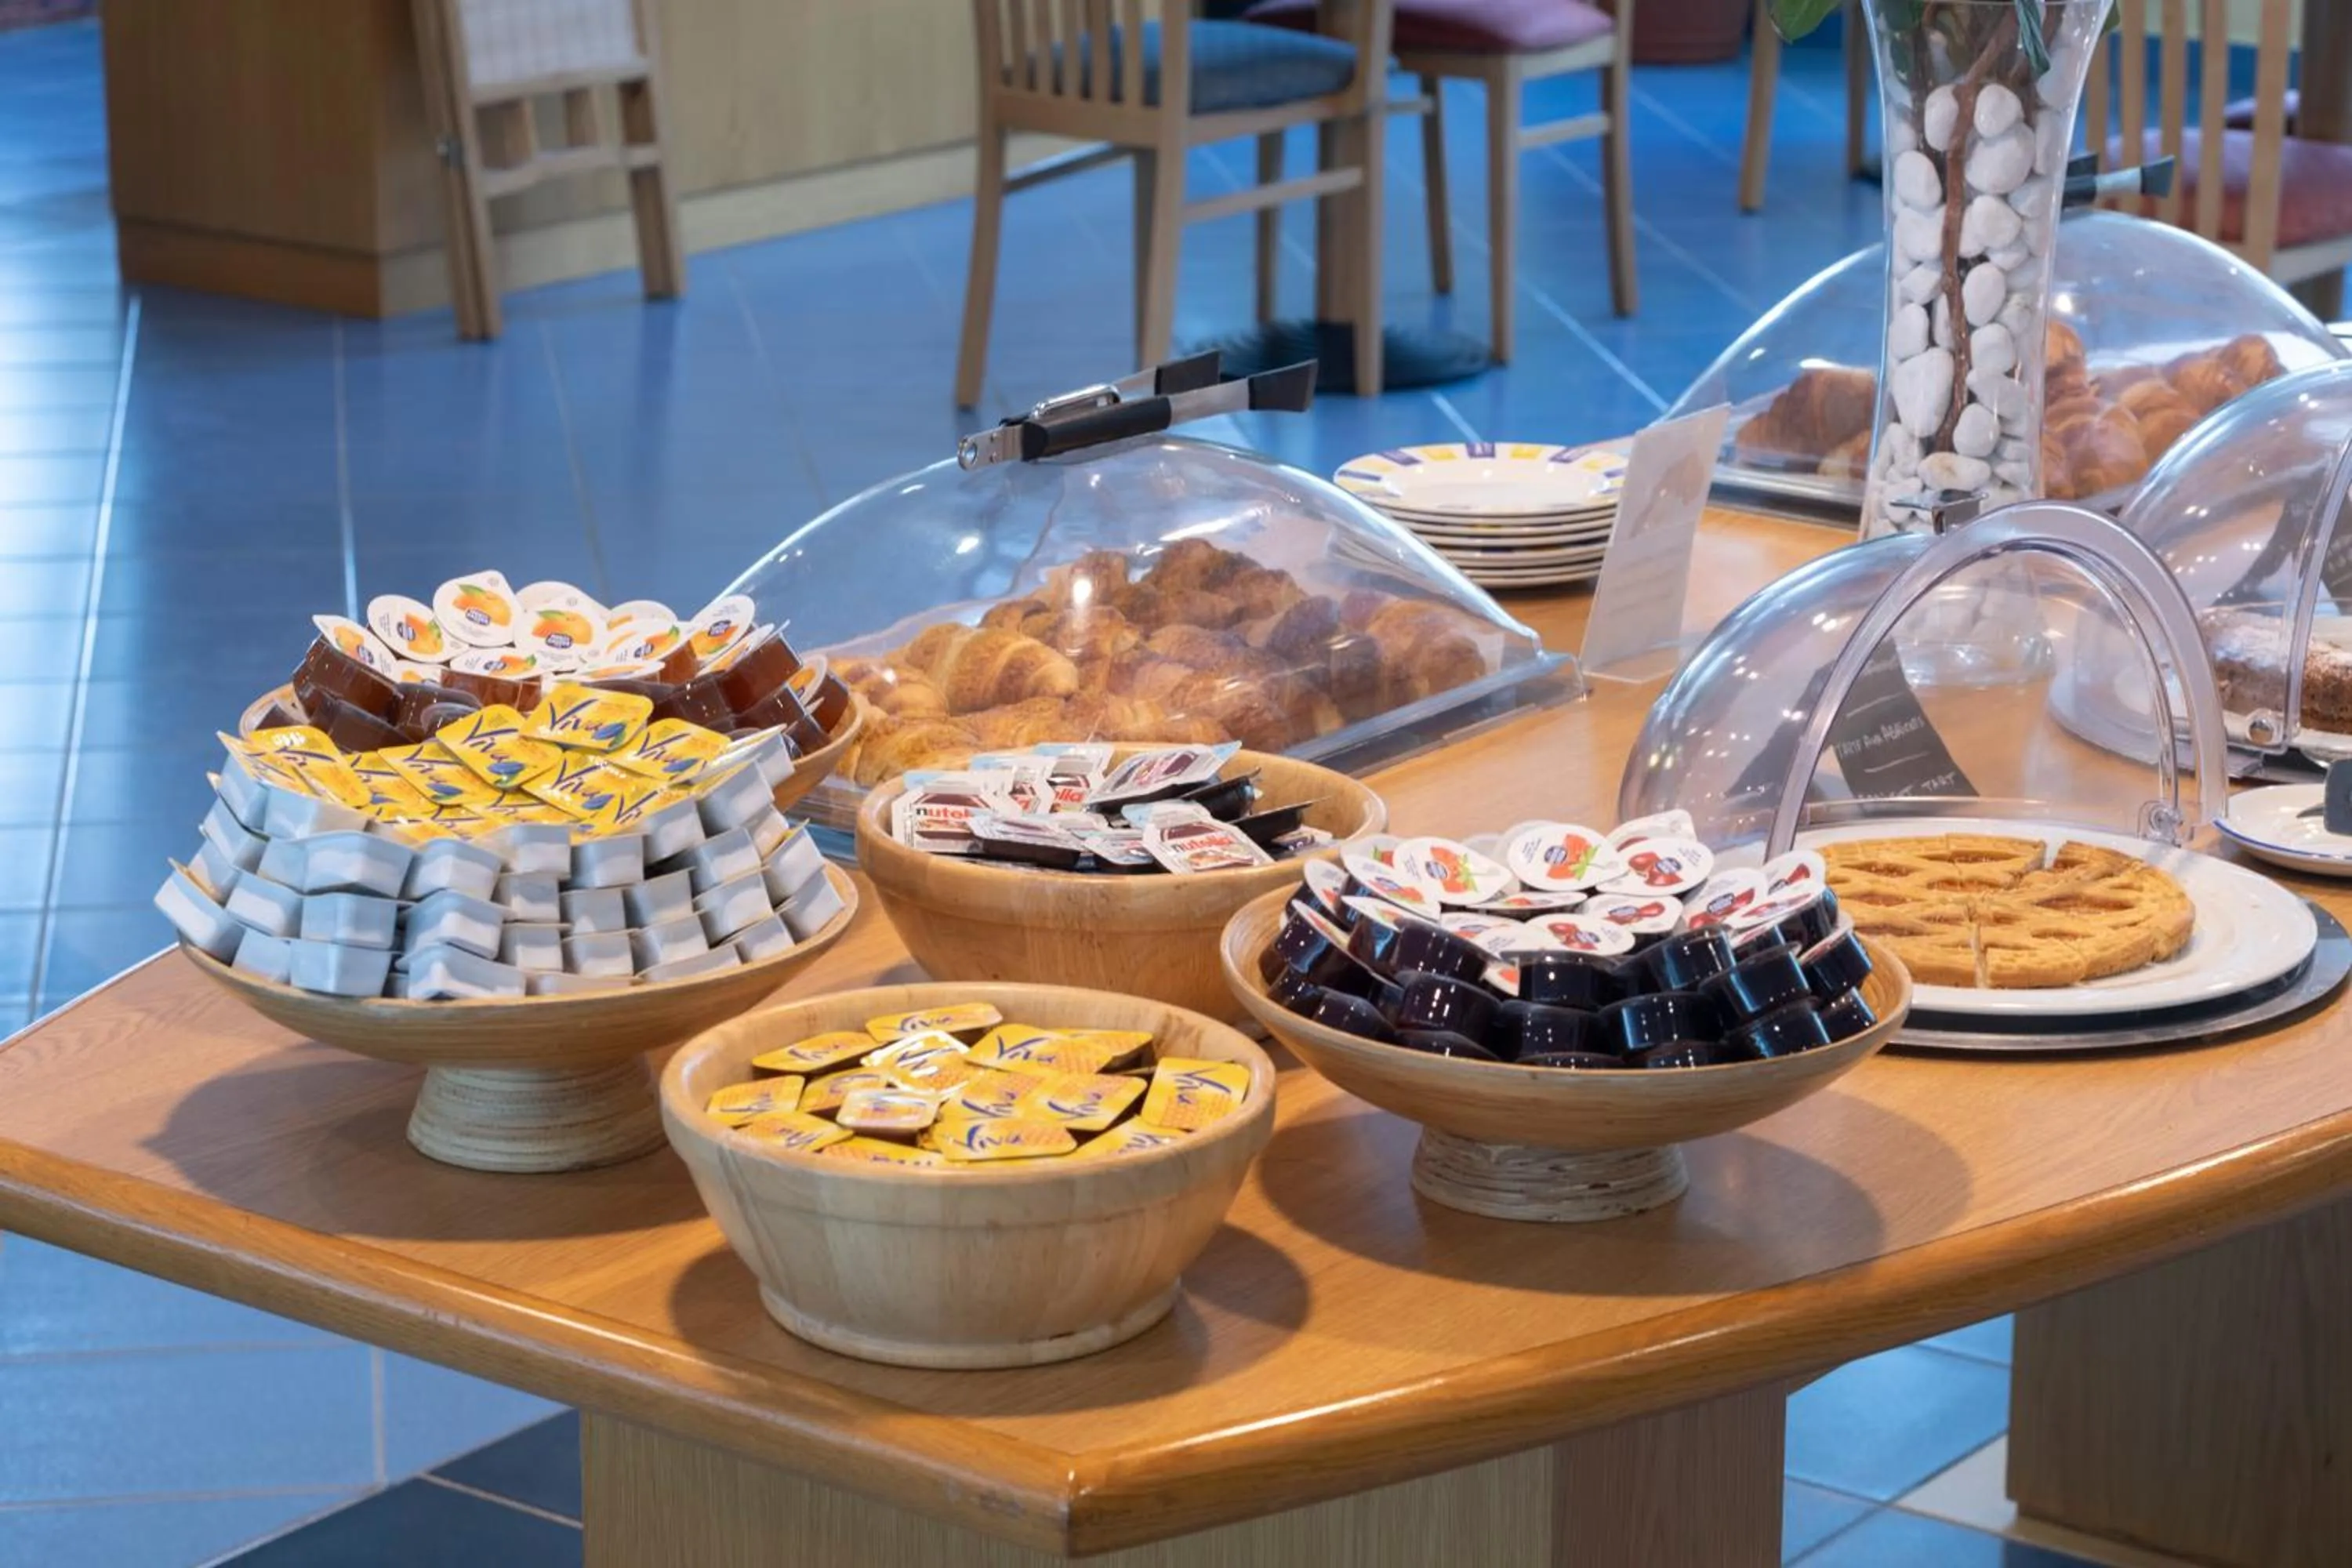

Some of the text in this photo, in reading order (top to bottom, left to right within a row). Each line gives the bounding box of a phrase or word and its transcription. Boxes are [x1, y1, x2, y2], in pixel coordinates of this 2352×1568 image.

[550, 698, 604, 731] Viva
[461, 714, 519, 763] Viva
[996, 1034, 1055, 1063] Viva
